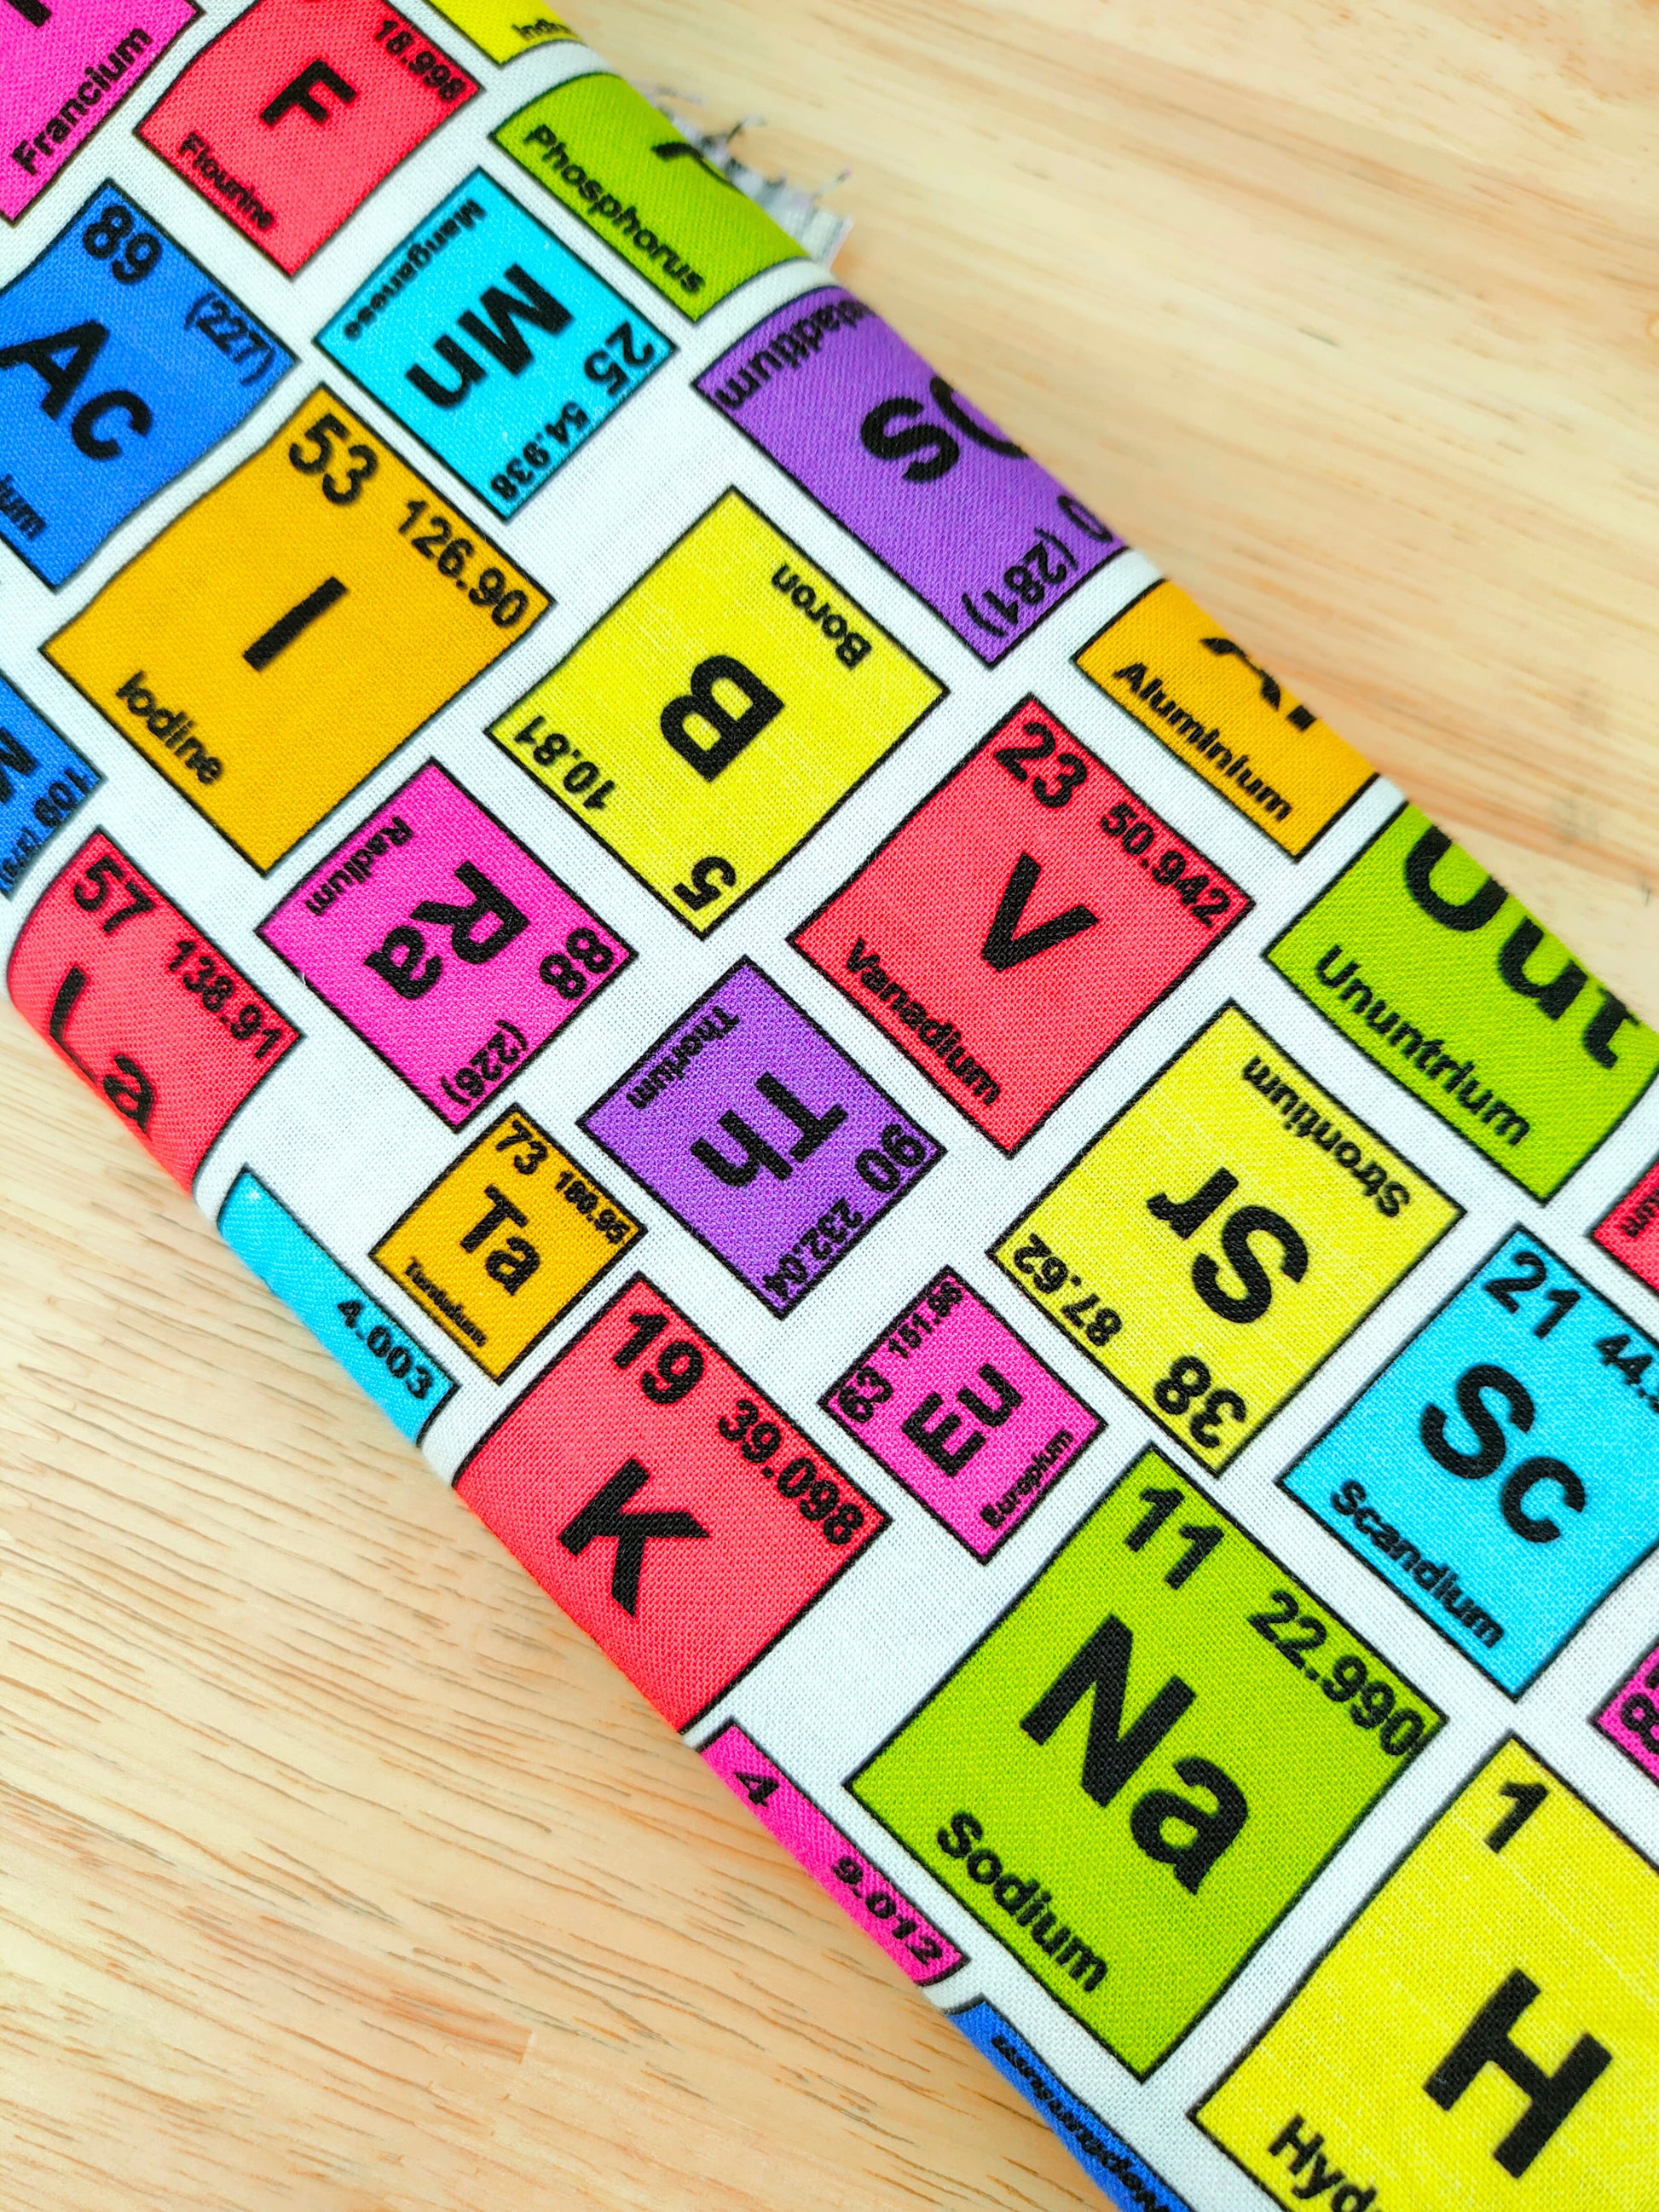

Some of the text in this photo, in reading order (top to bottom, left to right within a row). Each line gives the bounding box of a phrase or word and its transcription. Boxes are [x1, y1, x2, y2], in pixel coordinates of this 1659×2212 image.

[12, 27, 153, 176] Francium
[259, 56, 359, 127] F
[375, 20, 466, 103] 18.998
[523, 124, 705, 295] Phosphorus
[81, 205, 275, 385] 89 (227)
[404, 263, 573, 410] Mn
[0, 319, 153, 461] Ac
[490, 321, 654, 503] 25 54.938
[288, 413, 529, 628] 53 126.90
[962, 527, 1079, 638] (281)
[241, 575, 350, 673] I
[770, 563, 873, 670] Boron
[115, 670, 225, 786] Iodine
[514, 714, 618, 810] 10.81
[660, 654, 787, 783] B
[1112, 661, 1293, 822] Aluminium
[305, 817, 415, 916] Radium
[673, 856, 737, 911] 5
[992, 721, 1230, 927] 23 50.942
[74, 855, 158, 933] 57
[168, 939, 283, 1060] 138.91
[362, 860, 532, 1002] Ra
[979, 852, 1099, 973] V
[441, 927, 614, 1107] 88 (226)
[623, 1003, 740, 1111] Thorium
[845, 936, 1001, 1106] Vanadium
[1314, 944, 1531, 1146] Ununtrium
[493, 1119, 548, 1176] 73
[689, 1072, 849, 1187] Th
[1243, 1056, 1411, 1218] Strontium
[459, 1184, 541, 1297] Ta
[764, 1123, 927, 1303] 90 232.04
[1146, 1167, 1309, 1323] Sr
[337, 1298, 436, 1401] 4.003
[1012, 1233, 1123, 1348] 87.62
[1484, 1251, 1659, 1412] 21 44.
[611, 1310, 864, 1545] 19 39.098
[835, 1365, 894, 1424] 63
[901, 1363, 1024, 1478] Eu
[1153, 1355, 1246, 1450] 38
[1419, 1364, 1587, 1545] Sc
[558, 1458, 711, 1619] K
[1330, 1480, 1505, 1648] Scandium
[1136, 1487, 1425, 1756] 11 22.990
[1020, 1613, 1248, 1895] Na
[1483, 1782, 1550, 1854] 1
[732, 1770, 945, 1966] 4 9.012
[939, 1811, 1107, 1992] Sodium
[1424, 1968, 1613, 2180] H
[1268, 2117, 1384, 2212] Hyd
